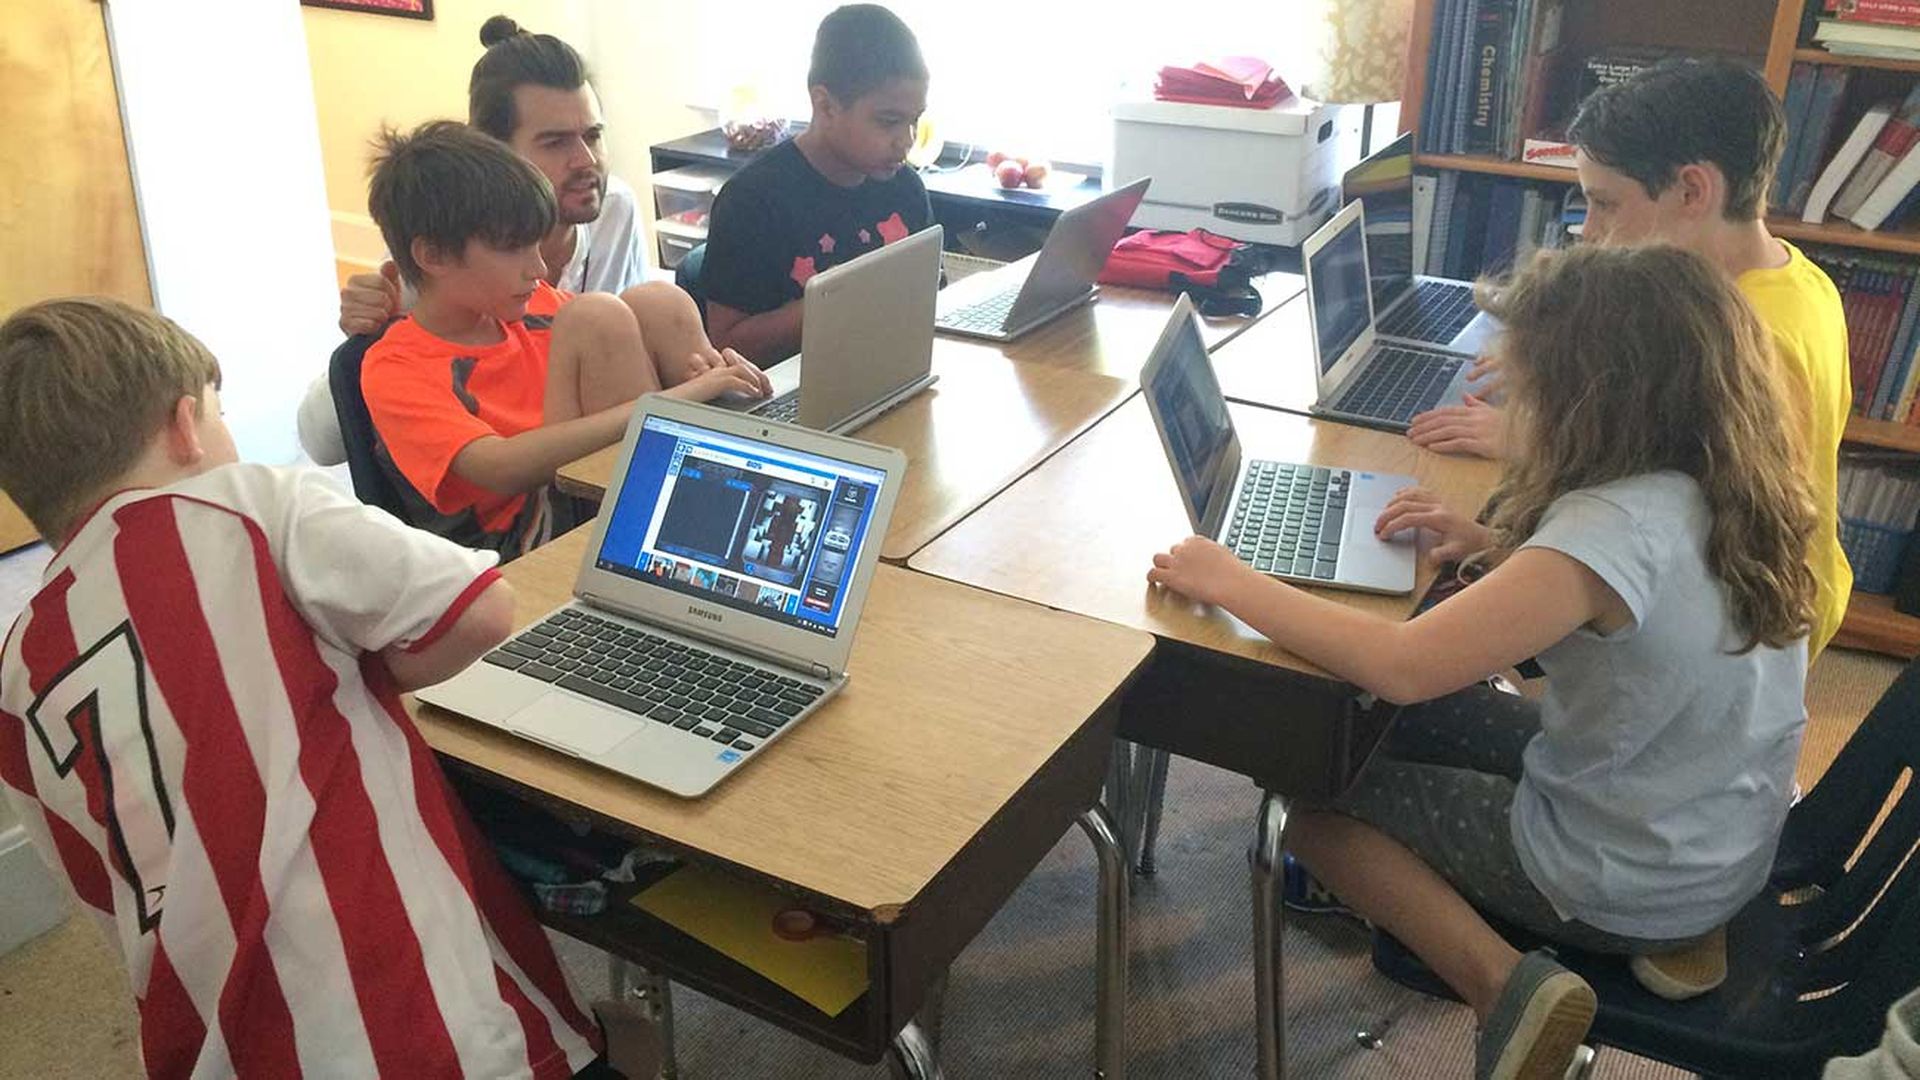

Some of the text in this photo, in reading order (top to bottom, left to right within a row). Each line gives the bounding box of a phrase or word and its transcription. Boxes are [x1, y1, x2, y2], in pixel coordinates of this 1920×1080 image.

[1473, 45, 1497, 126] Chemistry
[688, 605, 722, 622] SAMSUNG
[25, 618, 176, 936] 7
